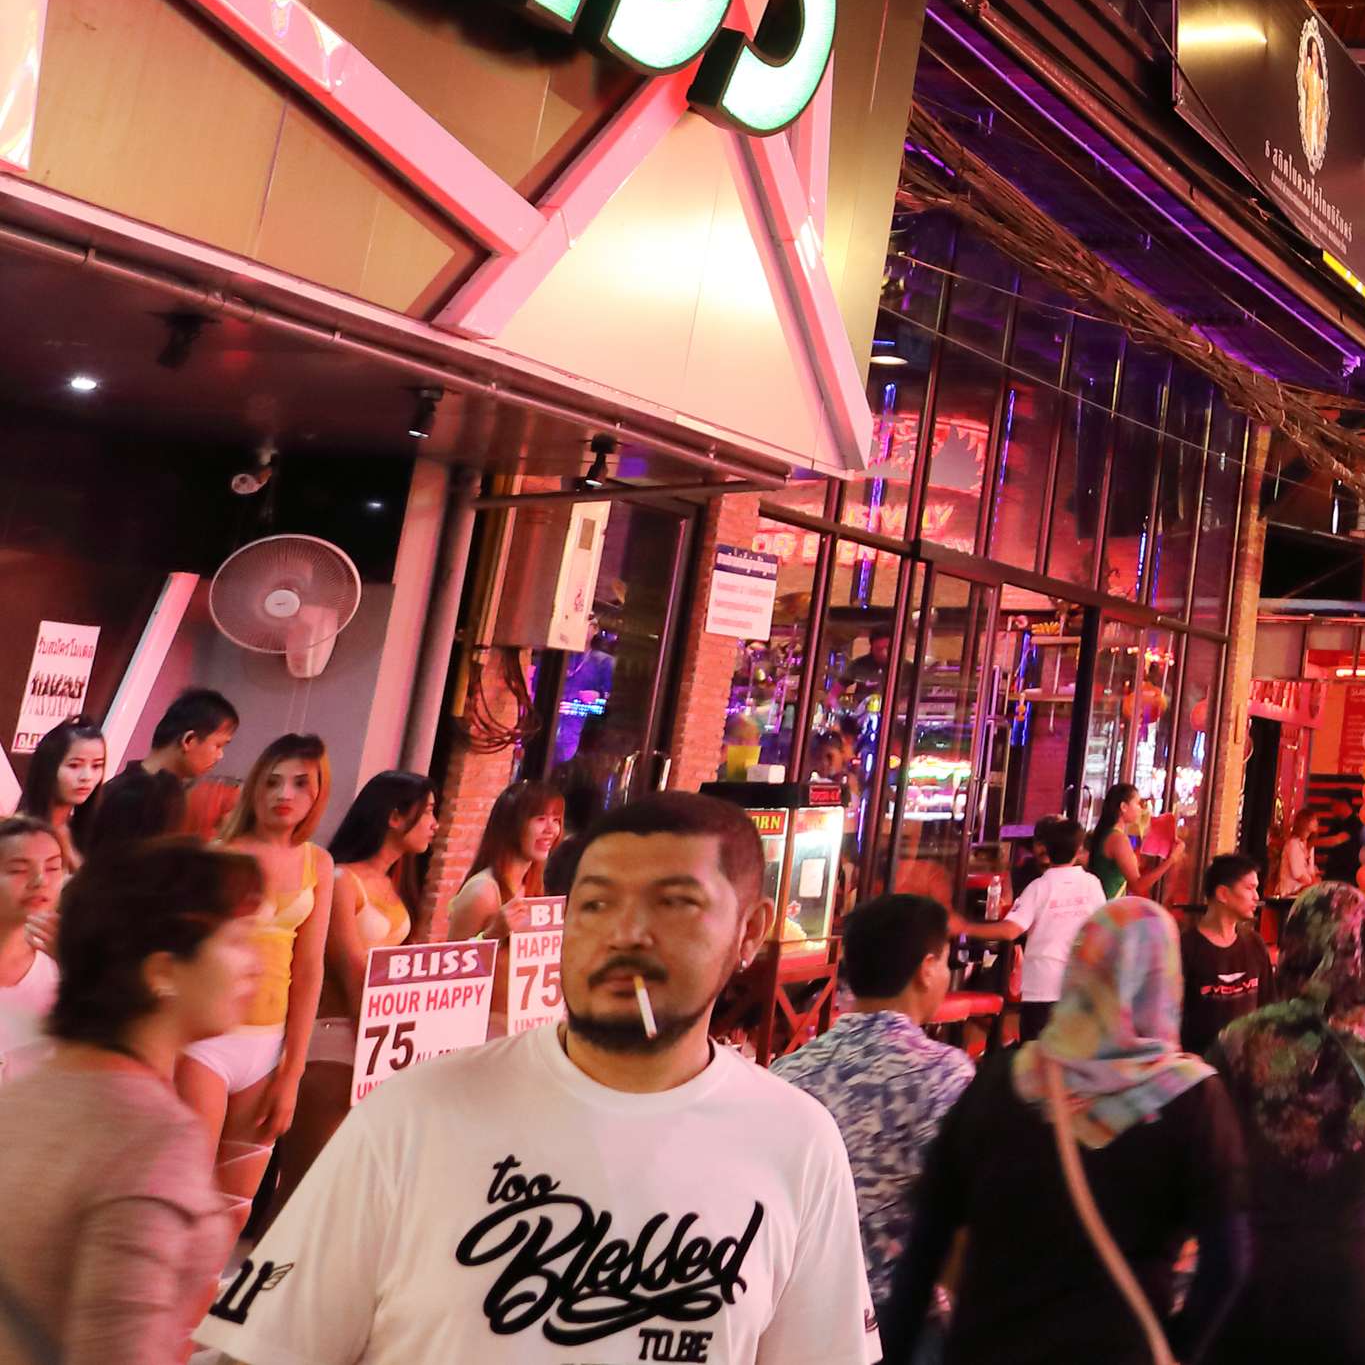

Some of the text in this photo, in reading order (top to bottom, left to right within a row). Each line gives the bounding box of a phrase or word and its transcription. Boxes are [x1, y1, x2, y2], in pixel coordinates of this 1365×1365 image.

[387, 949, 480, 980] BLISS
[515, 962, 562, 1011] 75
[367, 983, 486, 1018] HOUR HAPPY
[364, 1020, 417, 1077] 75
[487, 1153, 561, 1205] too
[456, 1193, 765, 1347] Blessed
